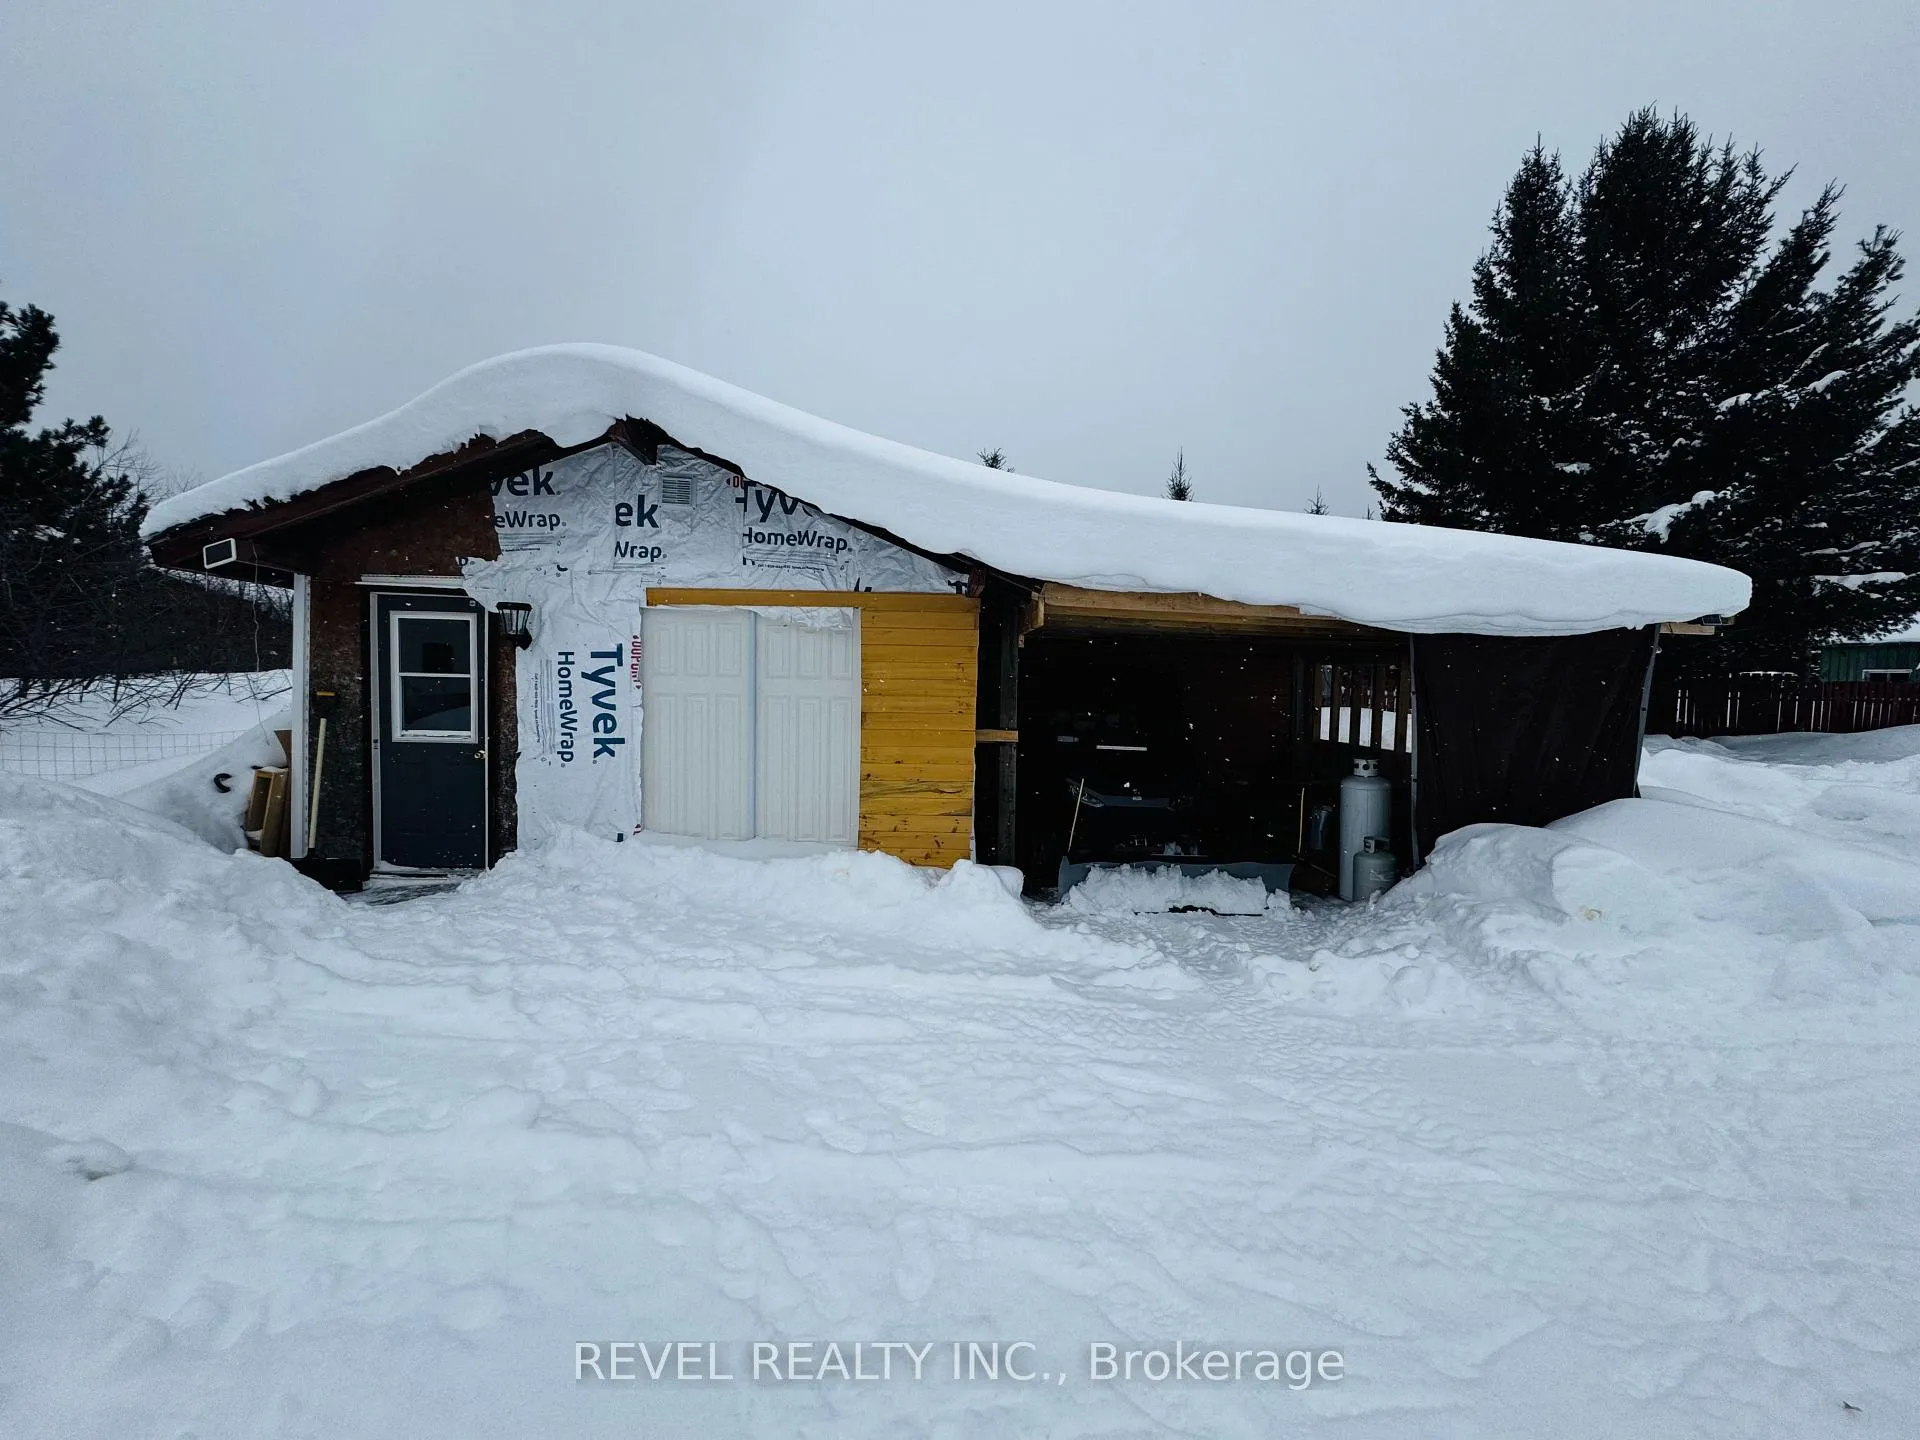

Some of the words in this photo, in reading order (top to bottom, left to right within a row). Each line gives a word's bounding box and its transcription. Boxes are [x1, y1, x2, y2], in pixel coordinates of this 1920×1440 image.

[615, 494, 659, 528] ek
[557, 651, 578, 763] HomeWrap
[581, 643, 626, 758] Tyvek
